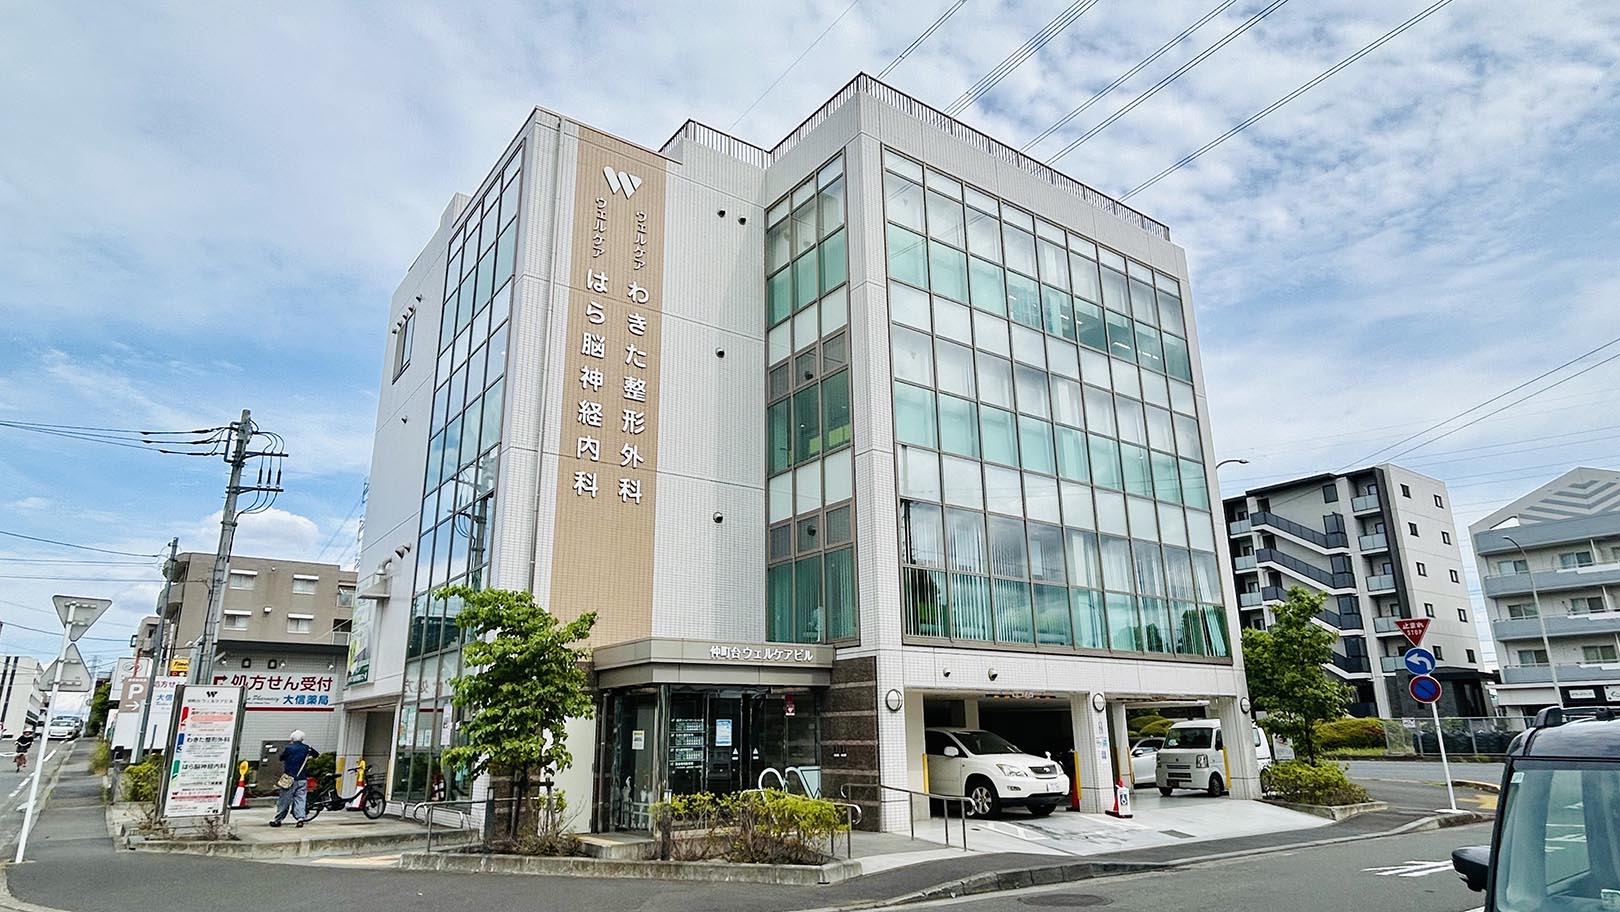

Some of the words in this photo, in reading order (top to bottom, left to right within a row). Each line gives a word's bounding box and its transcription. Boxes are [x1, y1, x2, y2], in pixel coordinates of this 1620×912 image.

[592, 197, 608, 258] ウェルケア
[633, 211, 648, 271] ウェルケア
[573, 268, 609, 499] はら脳神経内科
[618, 281, 650, 505] わきた整形外科
[710, 645, 813, 662] 仲町台ウェルケアビル
[128, 684, 144, 699] P
[231, 674, 333, 692] 処方せん受付
[283, 694, 329, 705] 大信薬局
